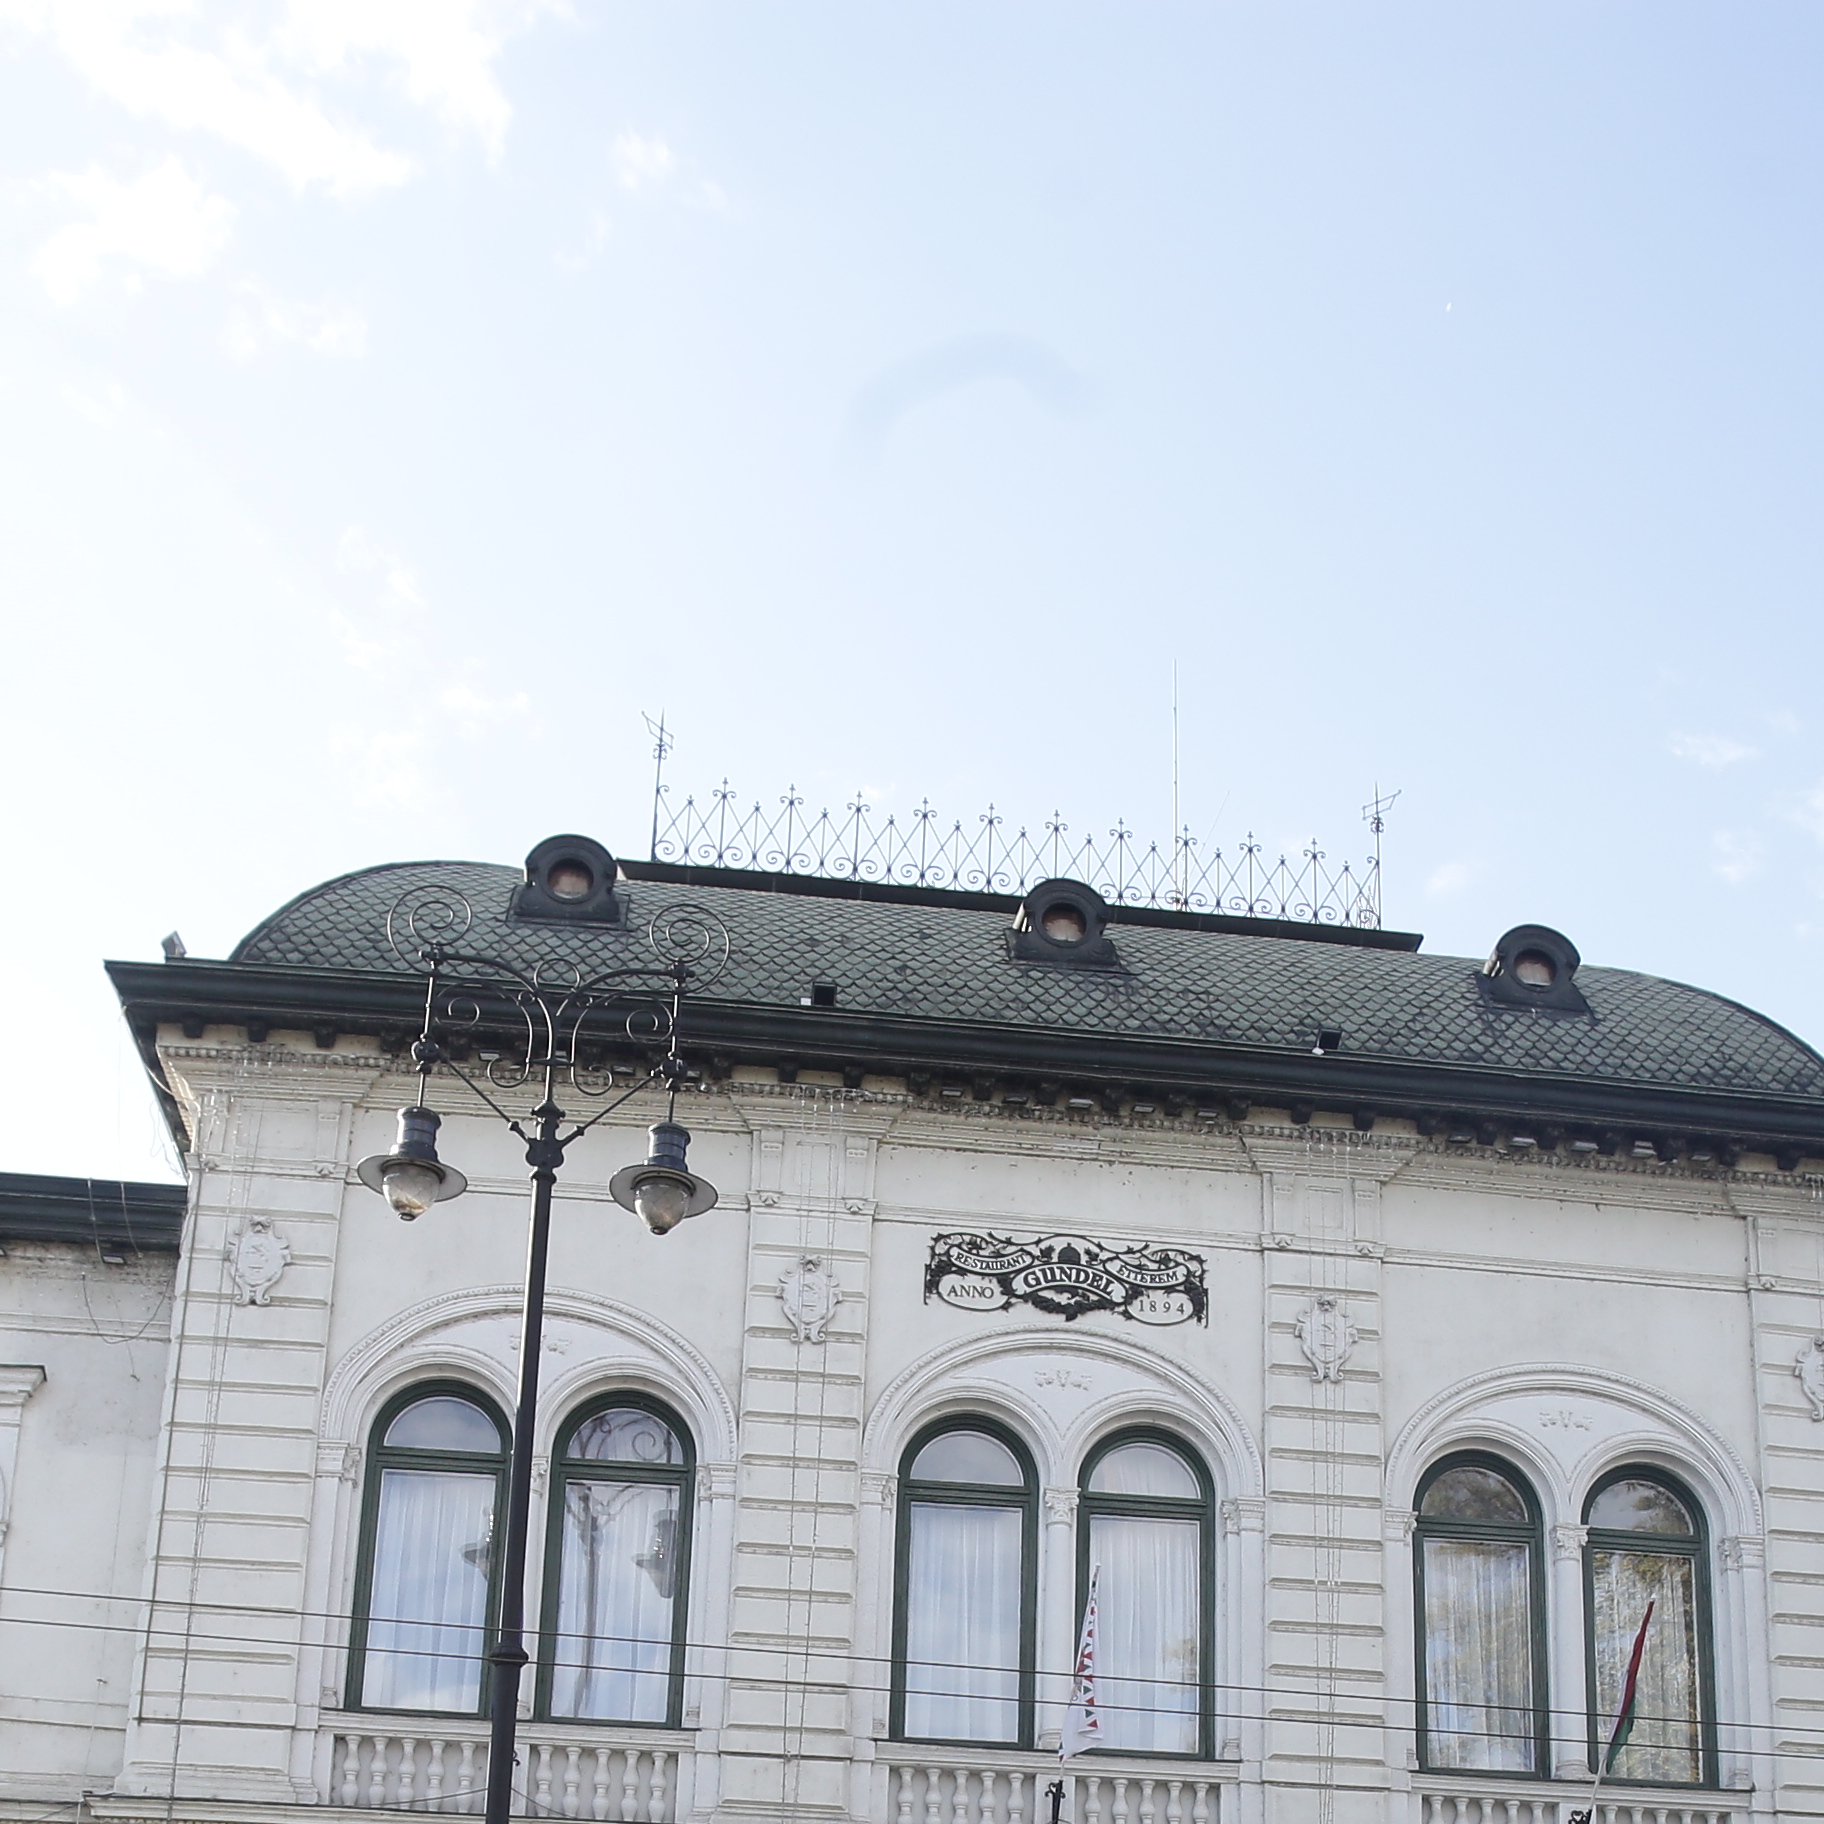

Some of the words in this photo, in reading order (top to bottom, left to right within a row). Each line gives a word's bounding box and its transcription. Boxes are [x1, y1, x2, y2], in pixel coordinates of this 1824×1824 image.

[954, 1251, 1027, 1270] RESTAURANT
[1023, 1266, 1116, 1297] GUNDEL
[947, 1284, 994, 1299] ANNO
[1138, 1300, 1185, 1315] 1894
